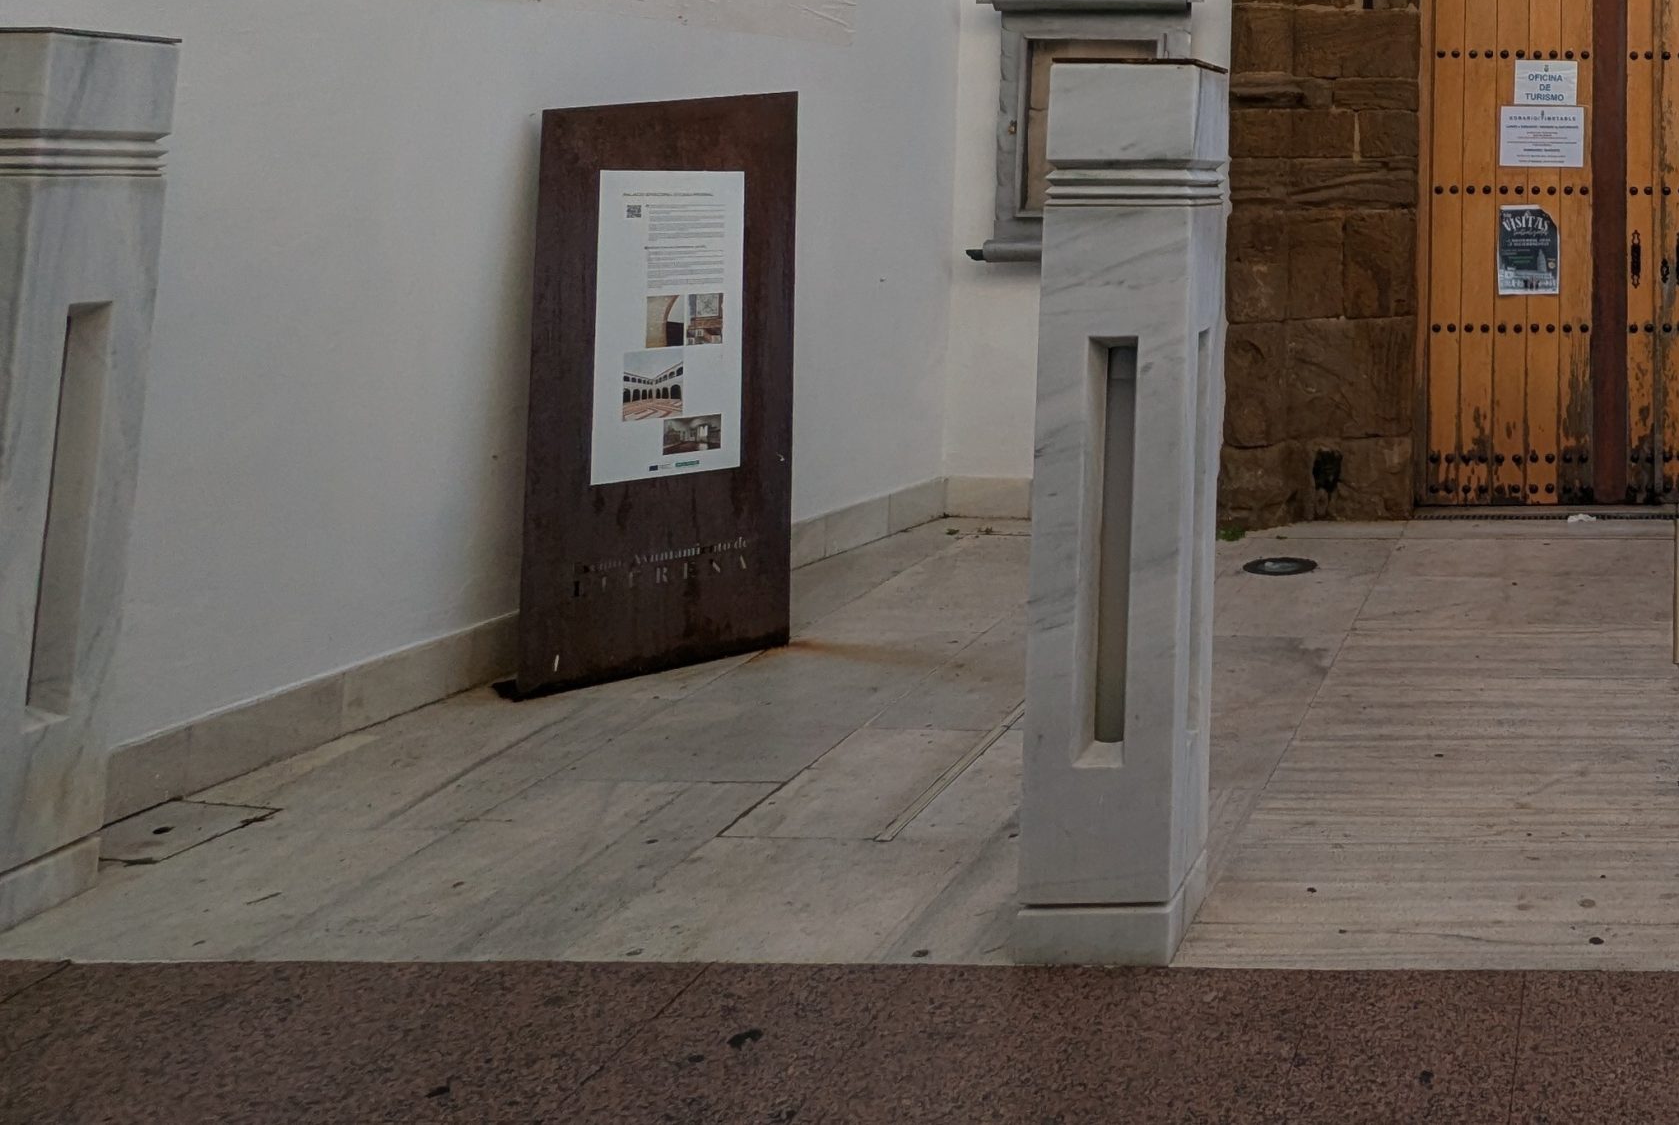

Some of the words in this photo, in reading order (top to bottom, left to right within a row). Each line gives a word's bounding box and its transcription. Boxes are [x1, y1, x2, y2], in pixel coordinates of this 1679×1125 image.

[1527, 73, 1563, 82] OFICINA
[1539, 83, 1551, 92] DE
[1525, 92, 1565, 102] TURISMO
[1502, 215, 1550, 232] VISITAS
